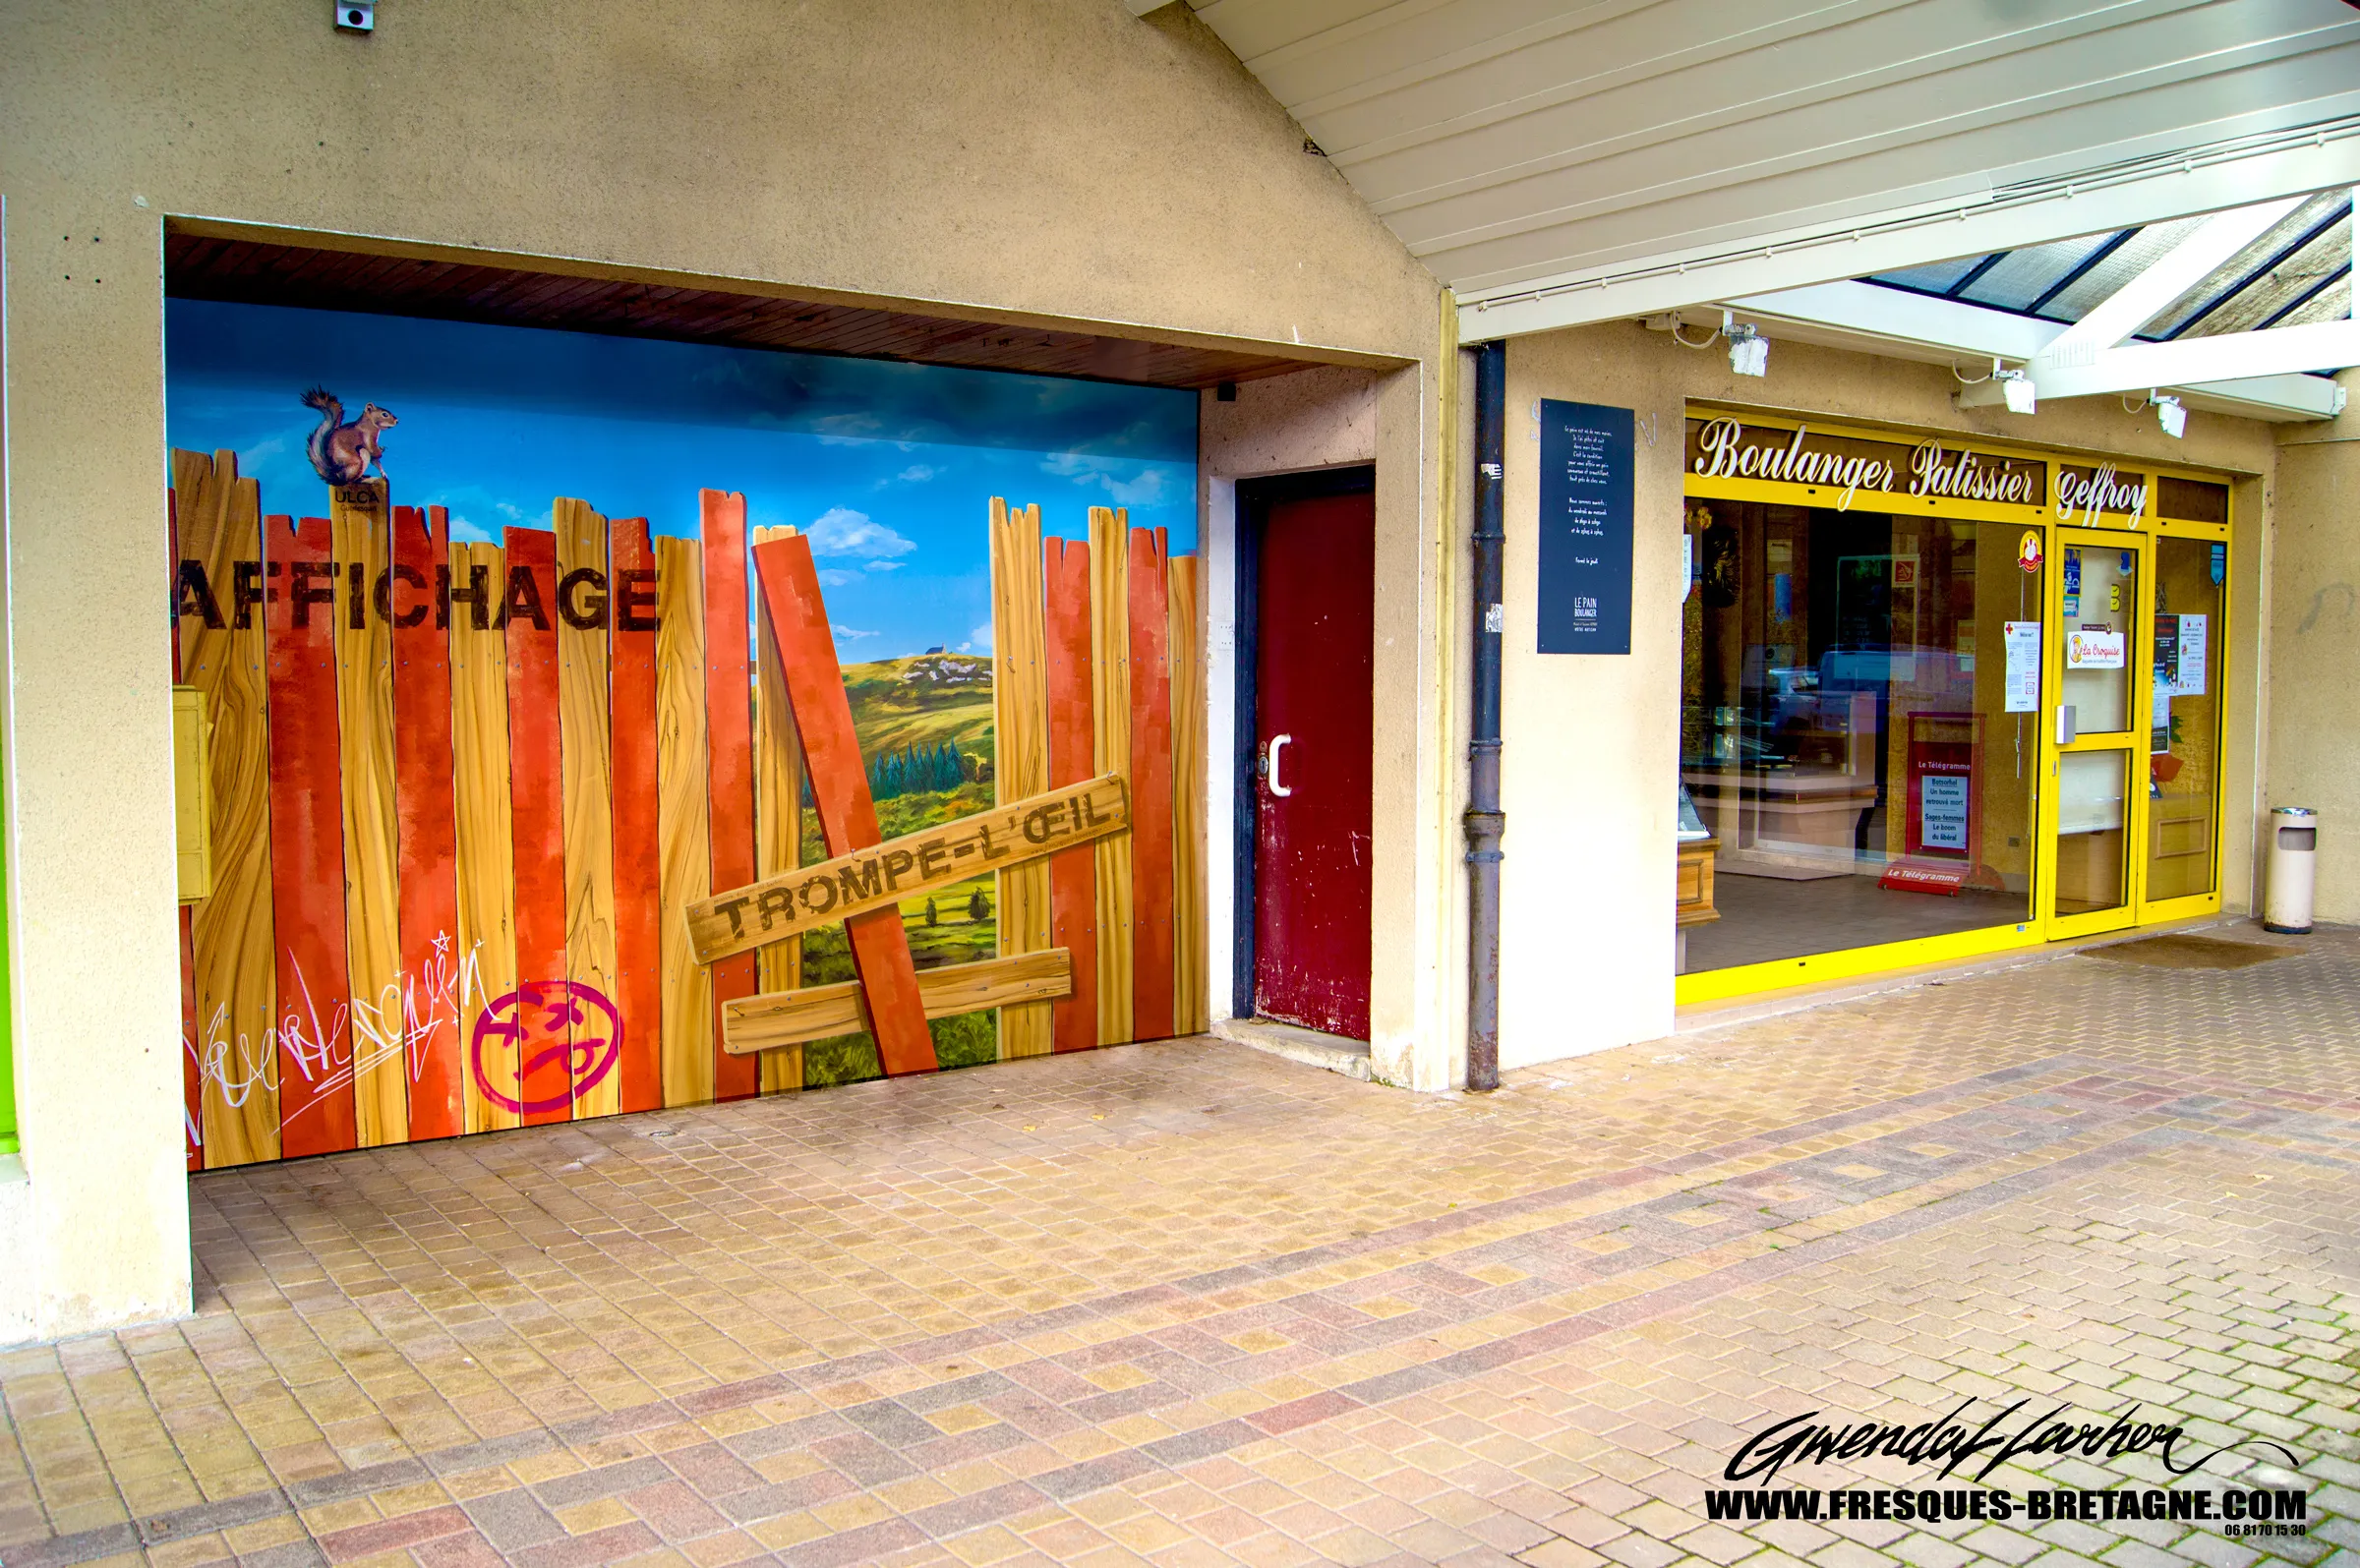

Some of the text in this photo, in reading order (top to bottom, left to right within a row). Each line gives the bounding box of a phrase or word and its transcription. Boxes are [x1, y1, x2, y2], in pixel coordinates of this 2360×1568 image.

[1694, 415, 2148, 530] Boulanger Patissier Geffroy
[335, 491, 380, 503] ULCA
[170, 558, 662, 631] AFFICHAGE
[1574, 597, 1597, 609] LE PAIN
[2082, 643, 2120, 659] La Croquise
[1928, 760, 1972, 772] Télégramme
[1924, 813, 1965, 822] Sages-femmes
[714, 792, 1111, 939] TROMPE-L'ŒIL
[1888, 869, 1960, 883] Le Télégramme
